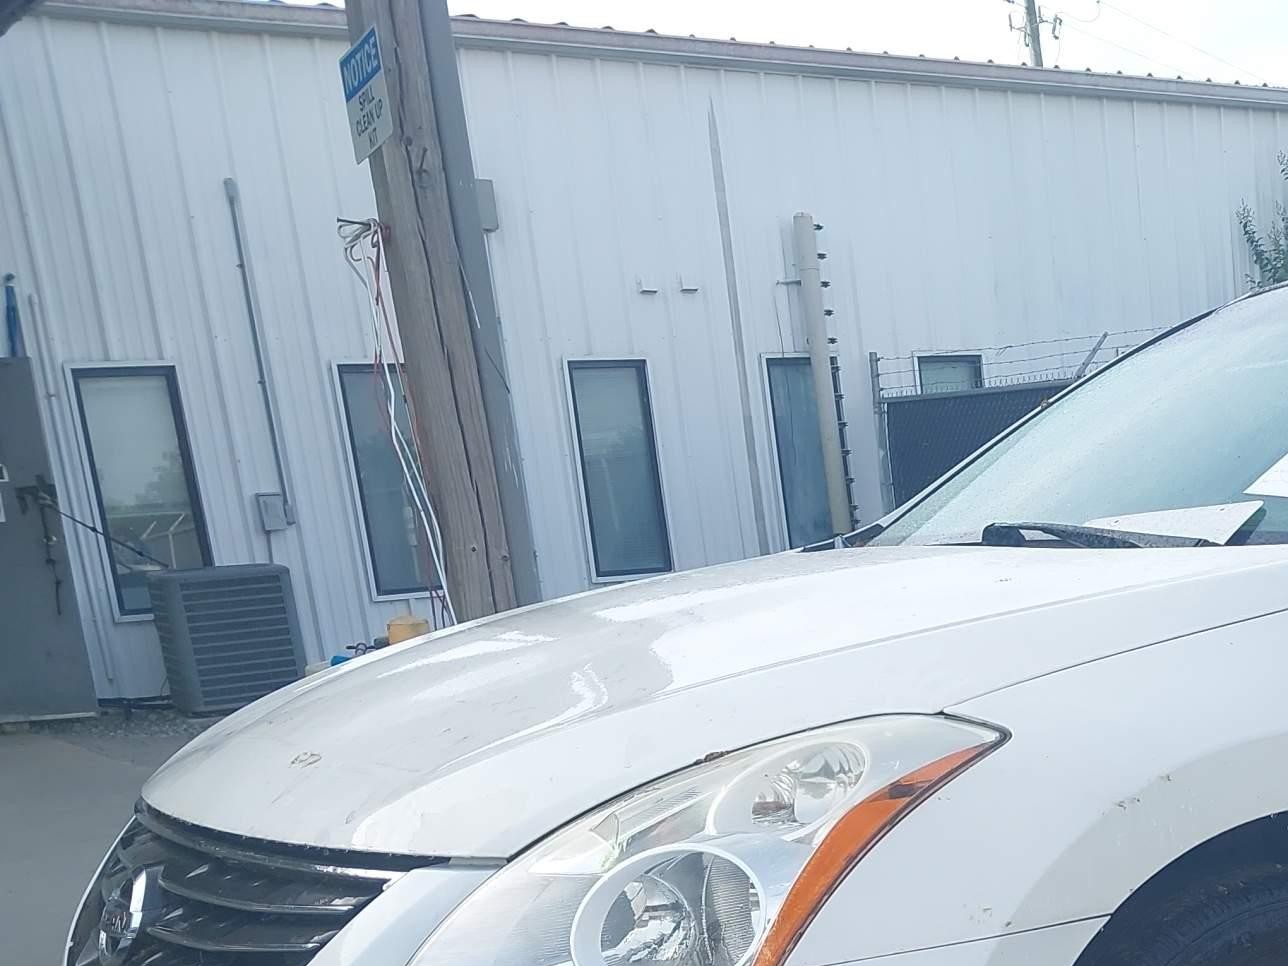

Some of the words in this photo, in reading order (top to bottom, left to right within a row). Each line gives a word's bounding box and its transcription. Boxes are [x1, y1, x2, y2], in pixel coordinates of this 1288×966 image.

[343, 36, 379, 96] NOTICE
[355, 106, 376, 137] CLEAN
[374, 98, 383, 120] UP
[358, 84, 375, 112] SPILL
